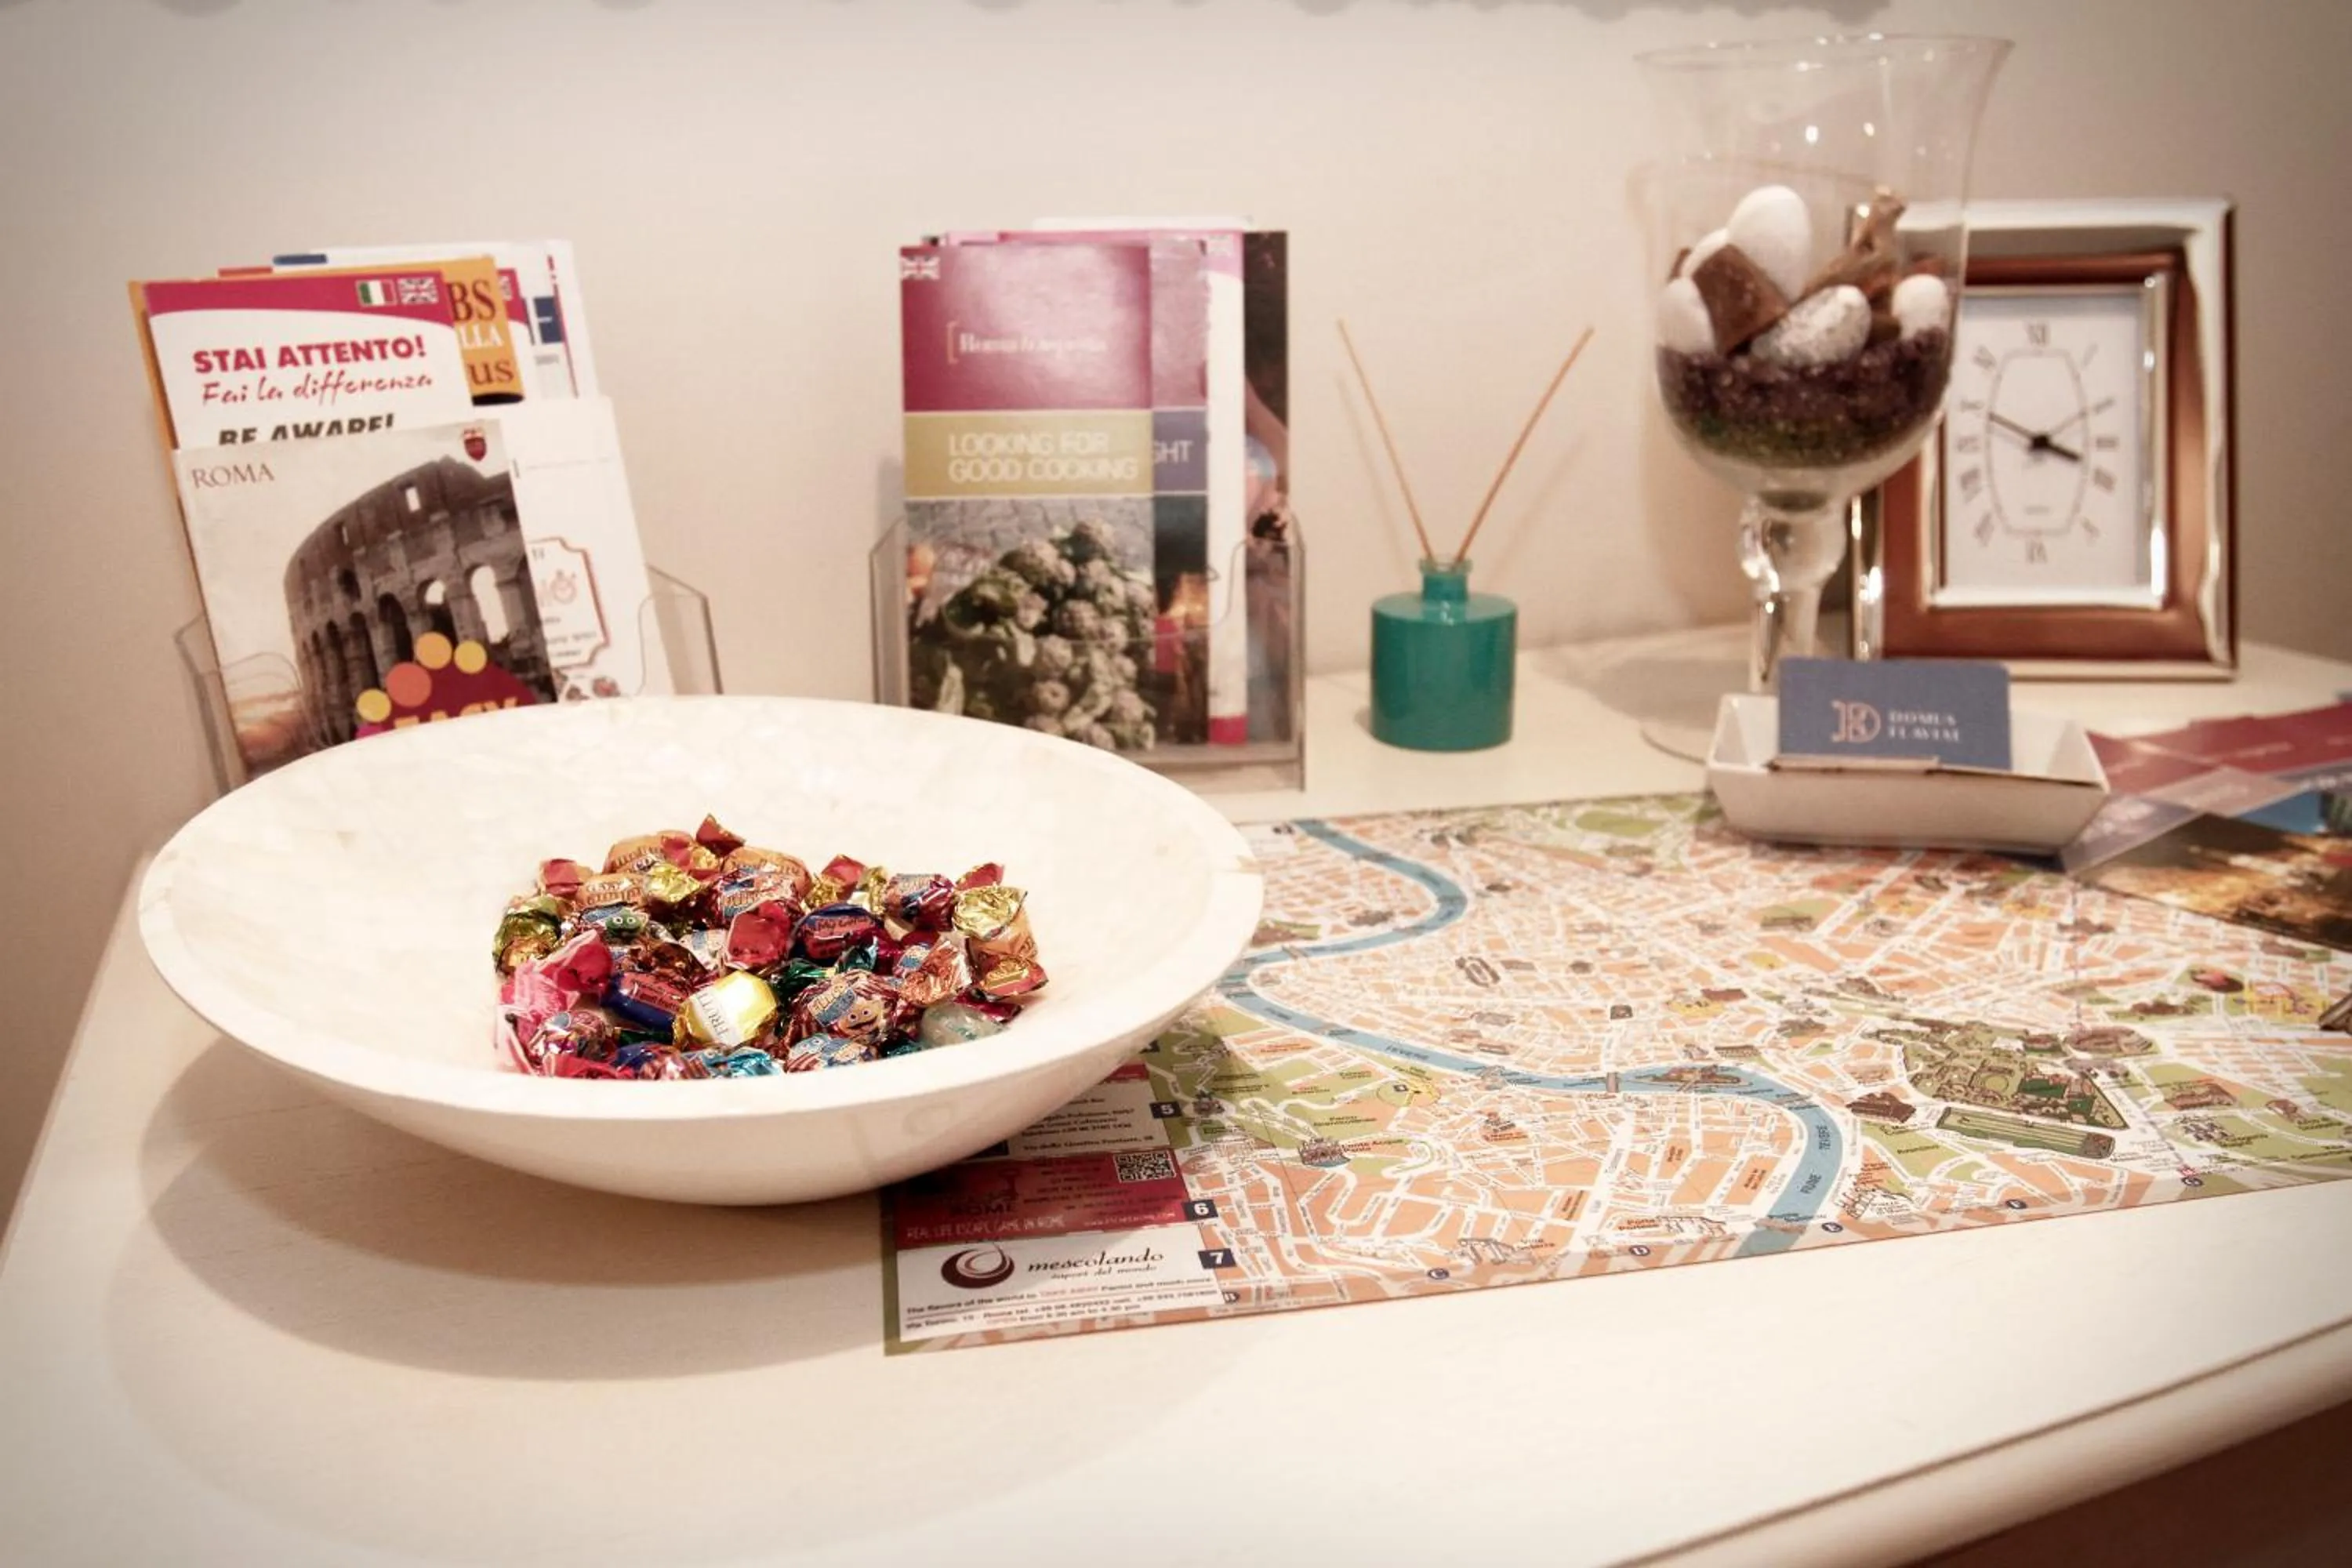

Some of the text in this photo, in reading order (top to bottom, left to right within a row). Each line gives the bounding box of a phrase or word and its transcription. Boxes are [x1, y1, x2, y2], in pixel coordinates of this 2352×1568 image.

[193, 335, 426, 373] STAI ATTENTO!
[201, 370, 432, 405] Fai la differenza
[949, 431, 1110, 457] LOOKING FOR
[192, 463, 274, 489] ROMA
[949, 456, 1138, 484] GOOD COOKING
[1160, 1104, 1175, 1115] 5
[1193, 1202, 1210, 1215] 6
[1028, 1247, 1165, 1273] mescolando
[1094, 1266, 1112, 1276] del
[1116, 1264, 1158, 1275] mondo
[1209, 1251, 1224, 1265] 7
